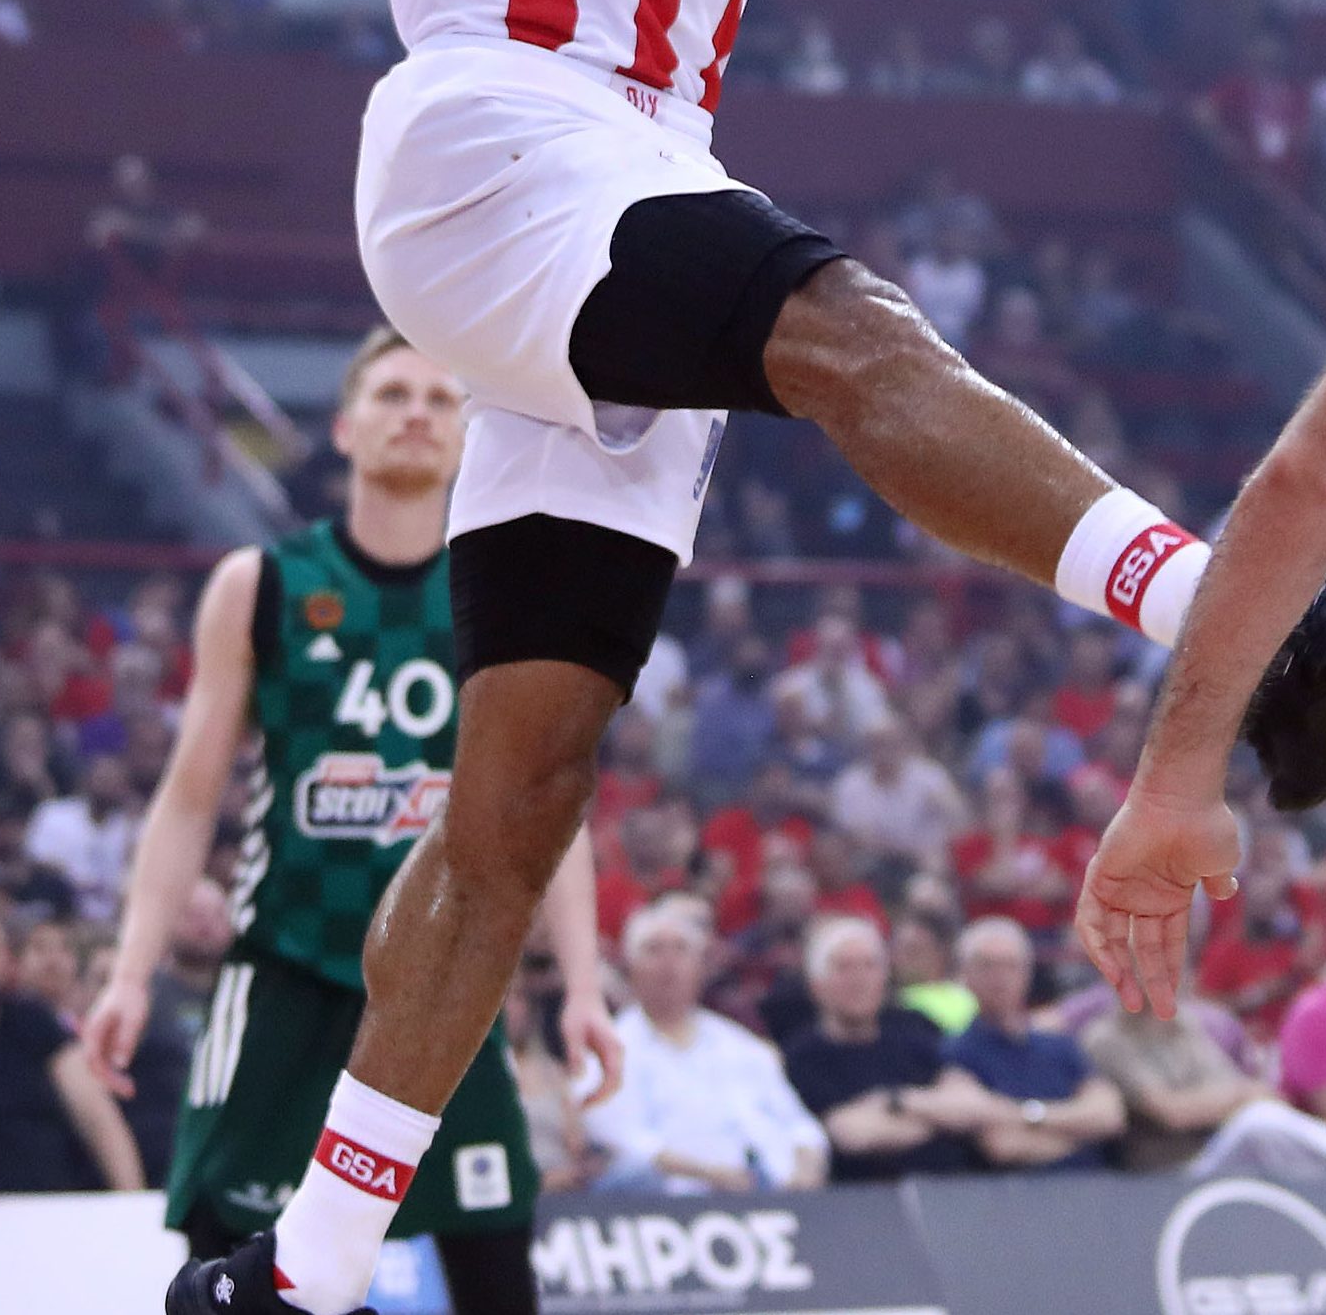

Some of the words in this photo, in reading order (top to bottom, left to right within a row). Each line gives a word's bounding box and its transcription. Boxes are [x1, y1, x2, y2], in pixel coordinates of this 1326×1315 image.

[1112, 530, 1182, 606] GSA
[336, 658, 454, 738] 40
[329, 1141, 398, 1195] GSA
